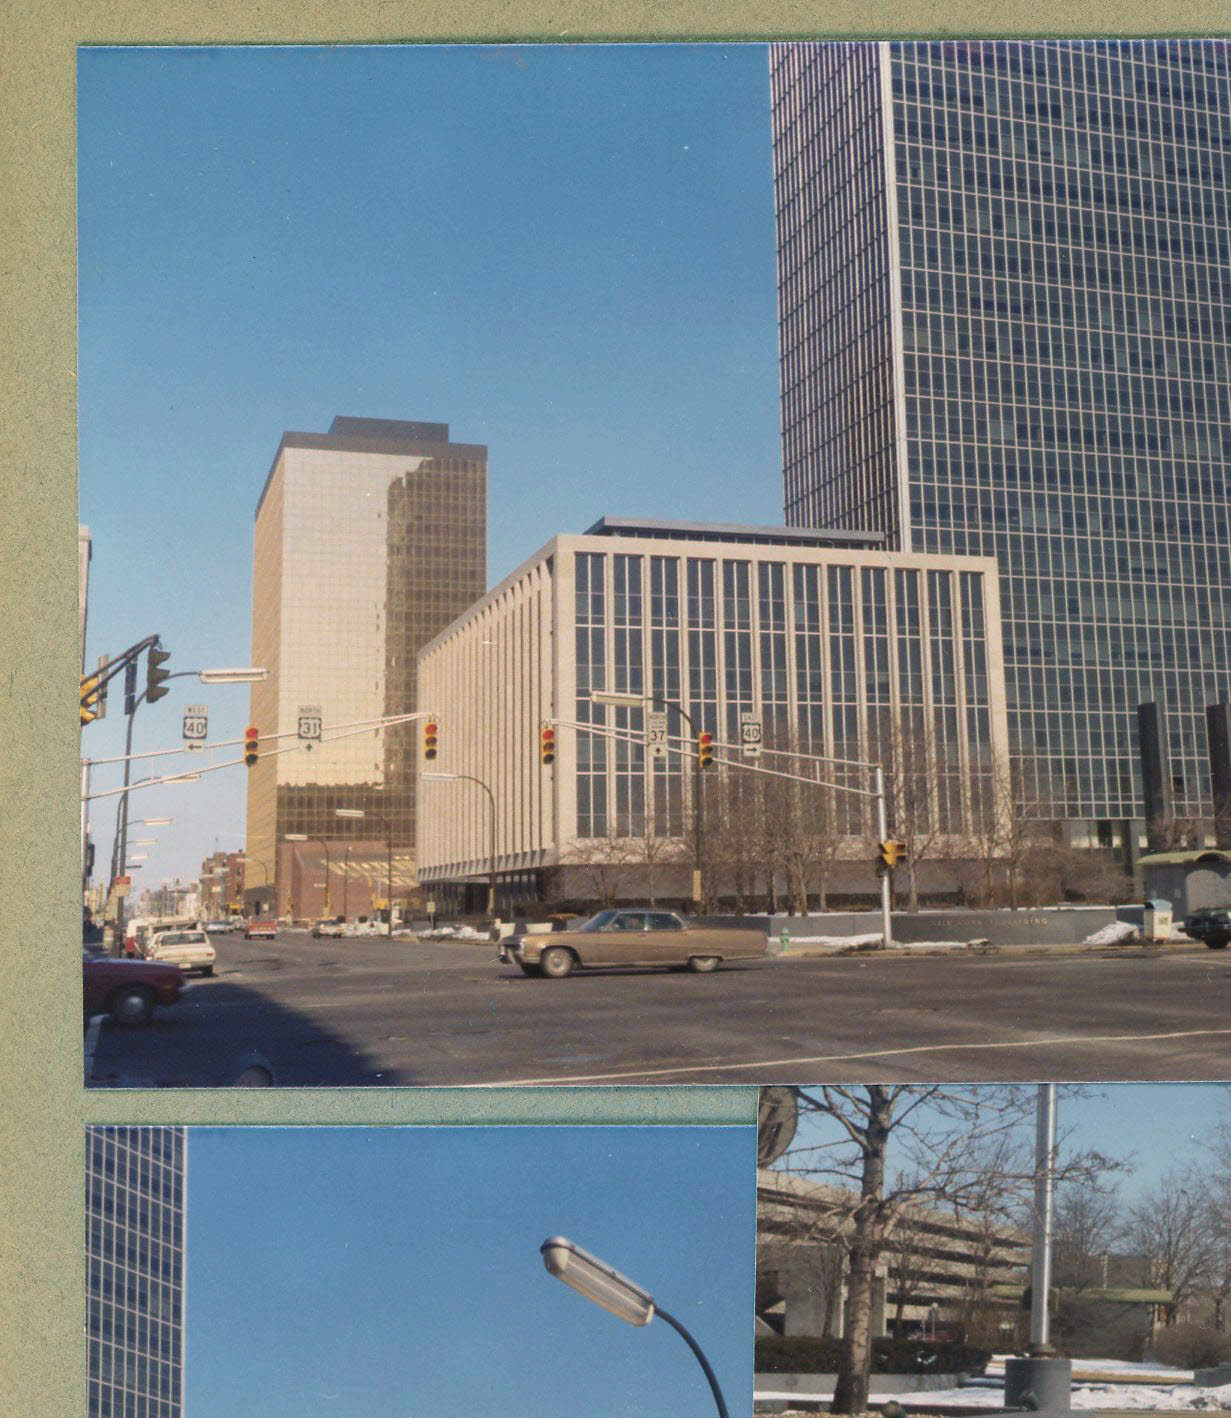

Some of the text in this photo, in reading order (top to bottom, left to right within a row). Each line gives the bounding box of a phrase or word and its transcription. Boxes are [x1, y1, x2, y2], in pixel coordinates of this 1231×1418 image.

[186, 722, 204, 735] 40
[302, 721, 318, 735] 31
[744, 728, 759, 739] 40
[650, 730, 665, 741] 37
